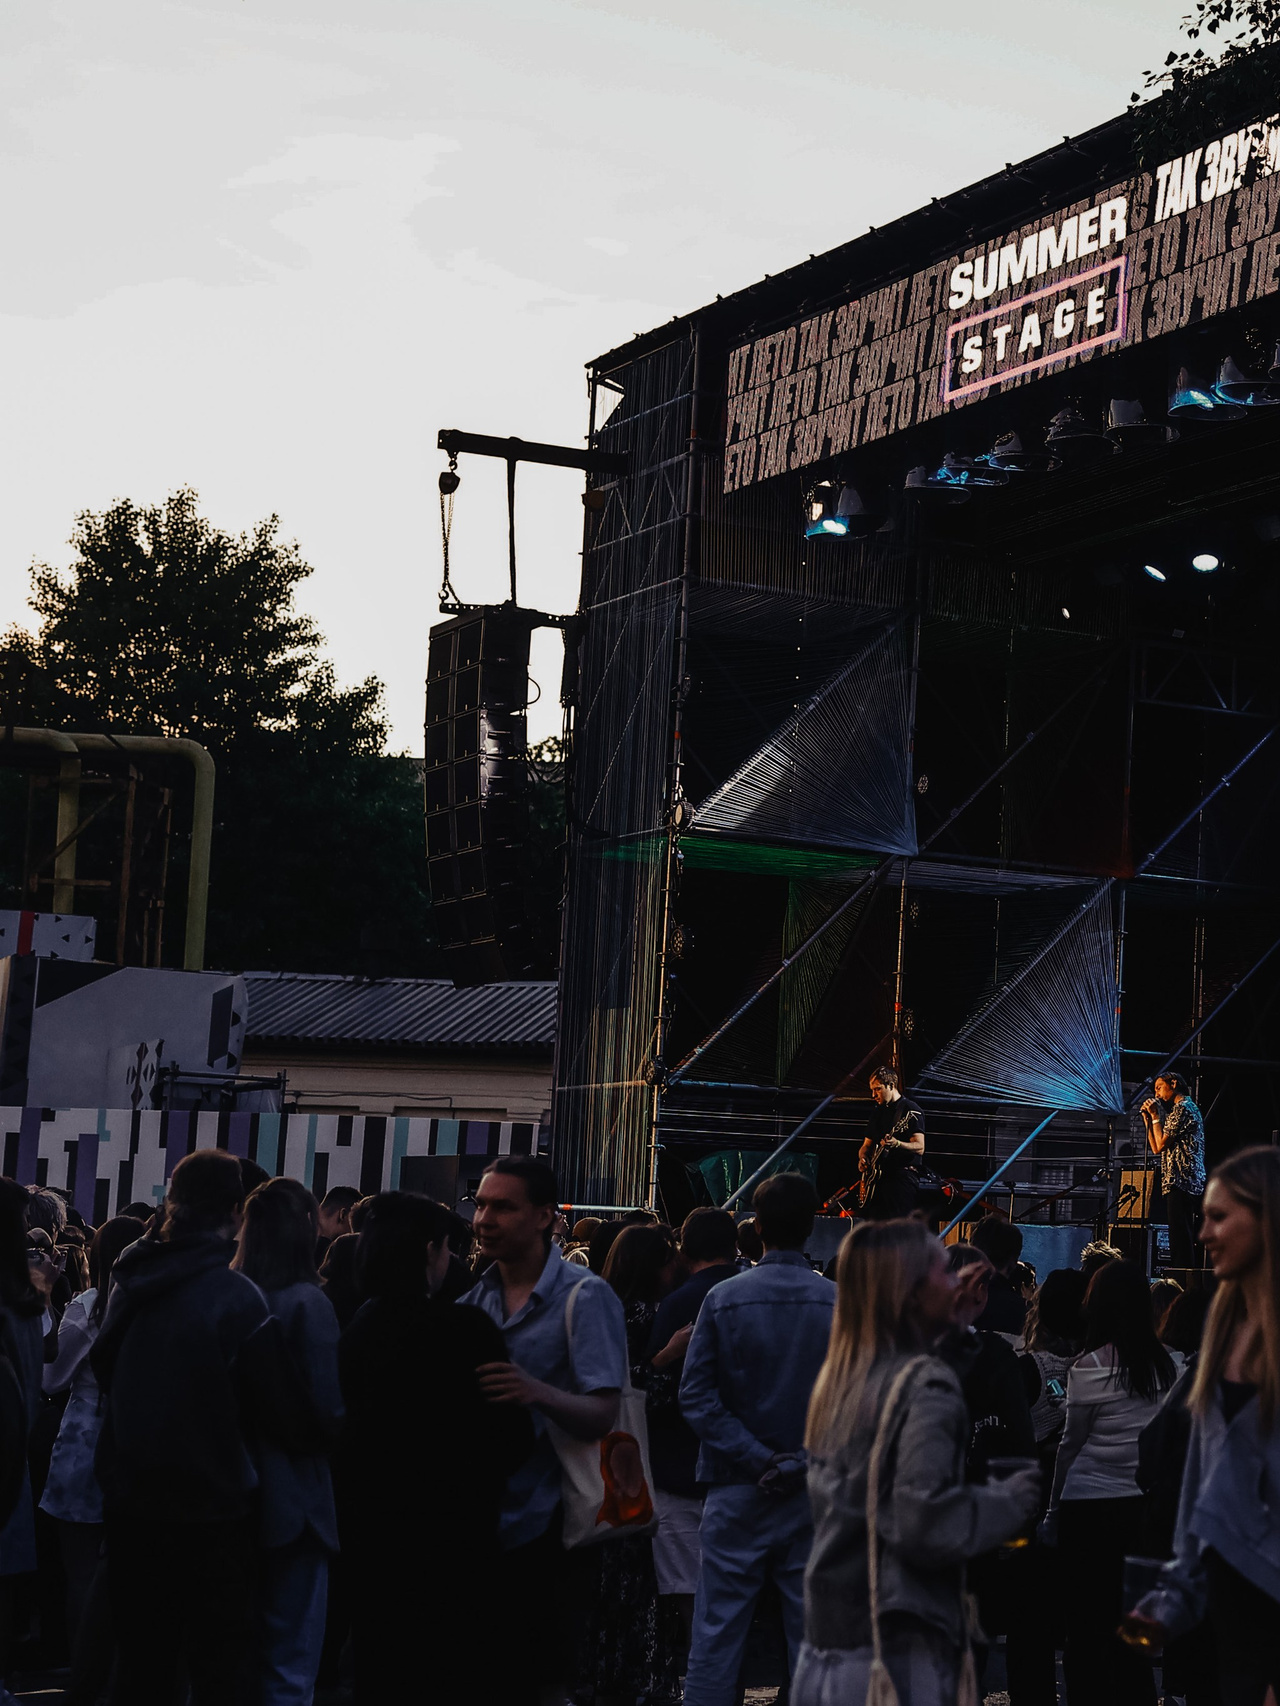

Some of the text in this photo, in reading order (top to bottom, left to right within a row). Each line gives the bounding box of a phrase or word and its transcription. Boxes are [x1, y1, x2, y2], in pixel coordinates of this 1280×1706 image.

[748, 326, 797, 389] ЛЕТО
[797, 310, 835, 372] ТАК
[832, 276, 910, 356] ЗВУЧИТ
[1155, 147, 1203, 223] ТАК
[757, 421, 793, 482] ТАК
[790, 394, 866, 470] ЗВУЧИТ
[862, 375, 916, 445] ЛЕТО
[1147, 245, 1248, 339] ЗВУЧИТ
[768, 366, 818, 430] ЛЕТО
[818, 350, 855, 412] ТАК
[853, 318, 931, 400] ЗВУЧИТ
[1184, 193, 1233, 268] ТАК
[949, 196, 1127, 310] SUMMER
[961, 286, 1107, 374] STAGE
